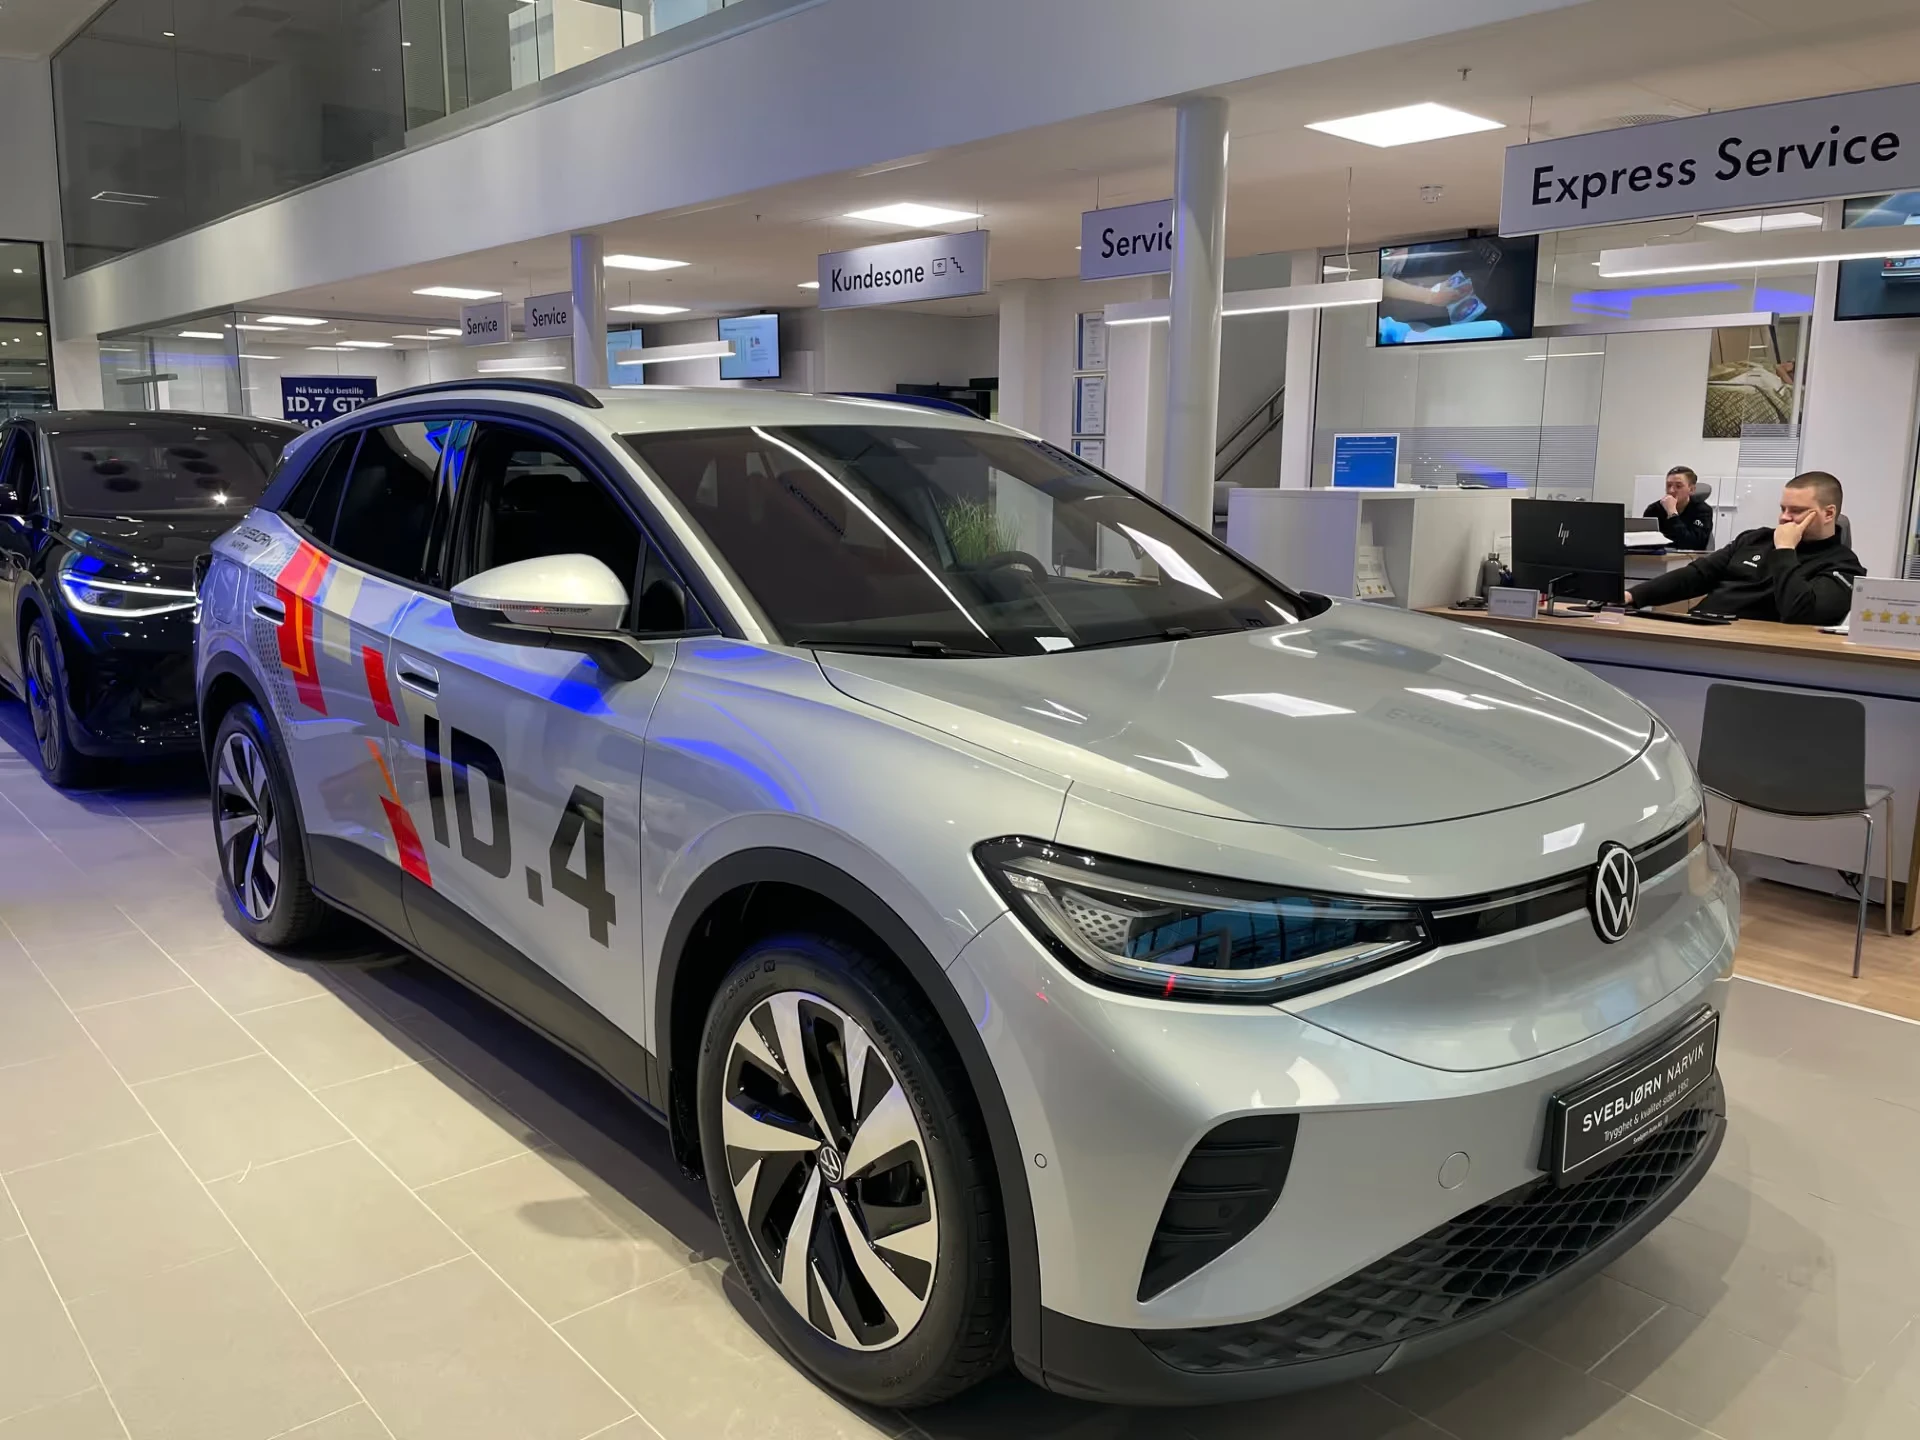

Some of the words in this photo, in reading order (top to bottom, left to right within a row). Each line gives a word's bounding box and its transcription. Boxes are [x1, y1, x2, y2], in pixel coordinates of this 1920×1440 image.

[1532, 158, 1696, 209] Express
[1715, 125, 1901, 181] Service
[1101, 222, 1172, 258] Servic
[832, 264, 925, 293] Kundesone
[467, 316, 498, 335] Service
[532, 306, 567, 327] Service
[287, 396, 326, 412] ID.7
[295, 386, 306, 394] Nå
[324, 387, 335, 395] du
[336, 387, 364, 395] bestille
[424, 714, 617, 949] ID.4
[1582, 1073, 1662, 1132] SVEBJØRN
[1667, 1042, 1705, 1084] NARVIK
[1604, 1119, 1633, 1142] Trygghet
[1633, 1113, 1640, 1125] &
[1640, 1101, 1663, 1121] kvalitet
